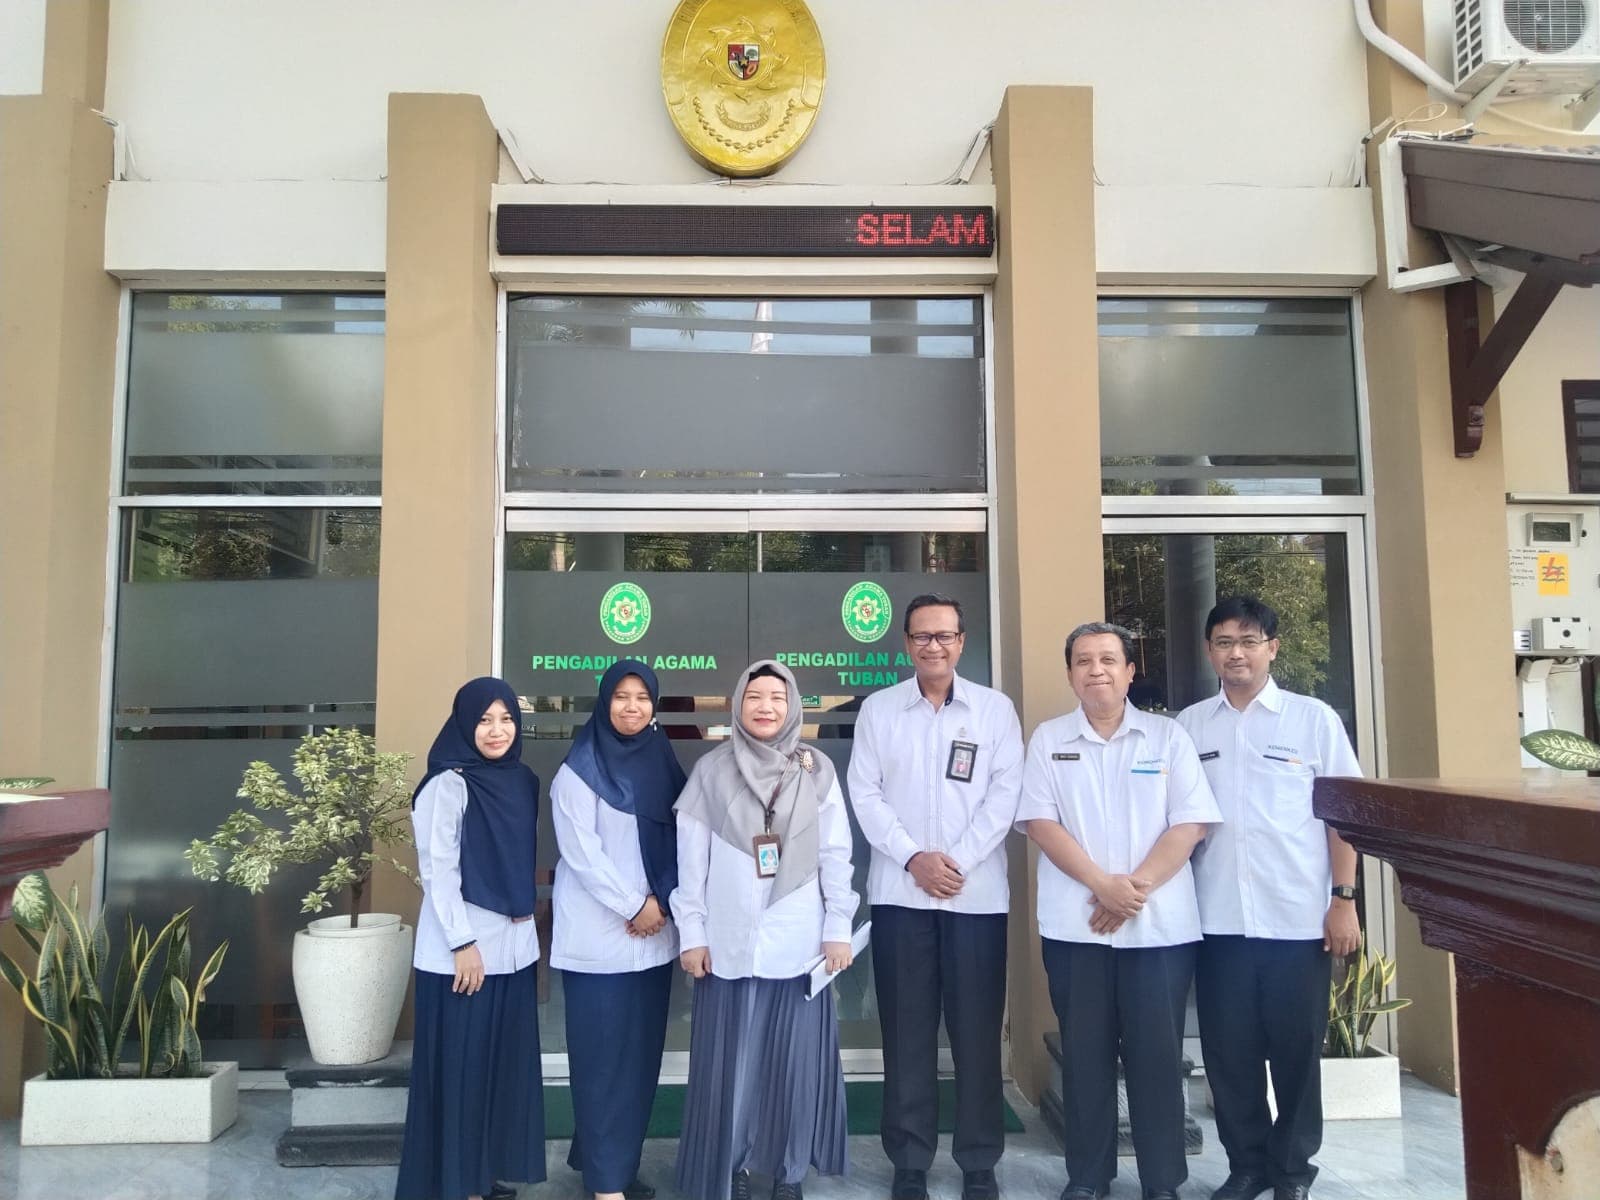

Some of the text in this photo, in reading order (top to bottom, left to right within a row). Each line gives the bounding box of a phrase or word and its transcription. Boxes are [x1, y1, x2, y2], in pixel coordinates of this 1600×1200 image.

[857, 212, 986, 245] SELAM
[532, 655, 717, 670] PENGADI AGAMA
[776, 652, 888, 667] PENGADILAN
[837, 671, 898, 686] TUBAN
